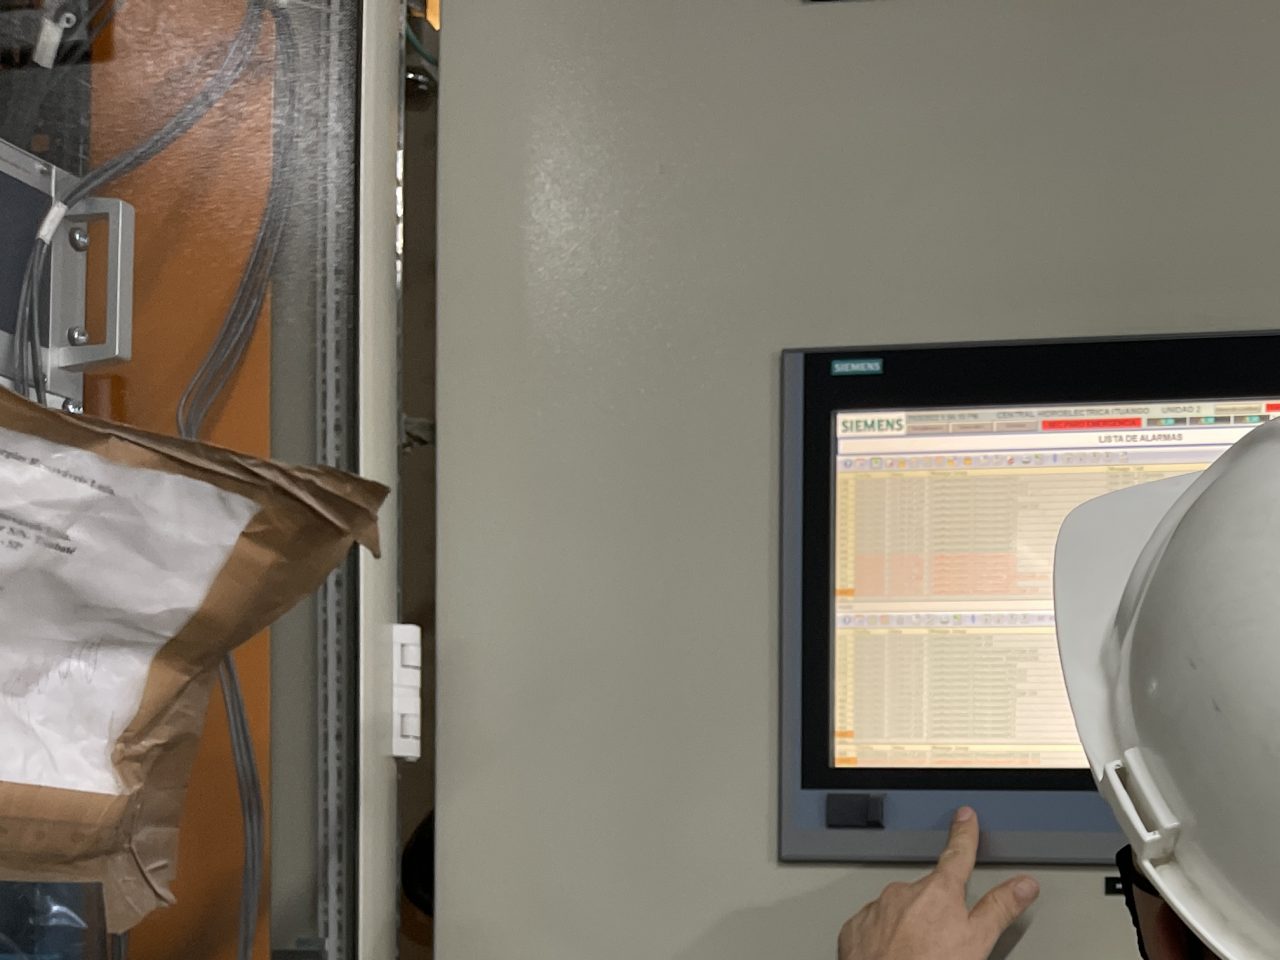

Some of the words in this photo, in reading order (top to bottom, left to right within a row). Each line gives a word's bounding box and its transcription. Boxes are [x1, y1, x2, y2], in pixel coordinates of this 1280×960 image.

[834, 362, 880, 373] SIEMENS
[841, 418, 904, 433] SIEMENS
[1098, 434, 1123, 444] LISTA
[1125, 434, 1138, 443] DE
[1140, 433, 1183, 443] ALARMAS
